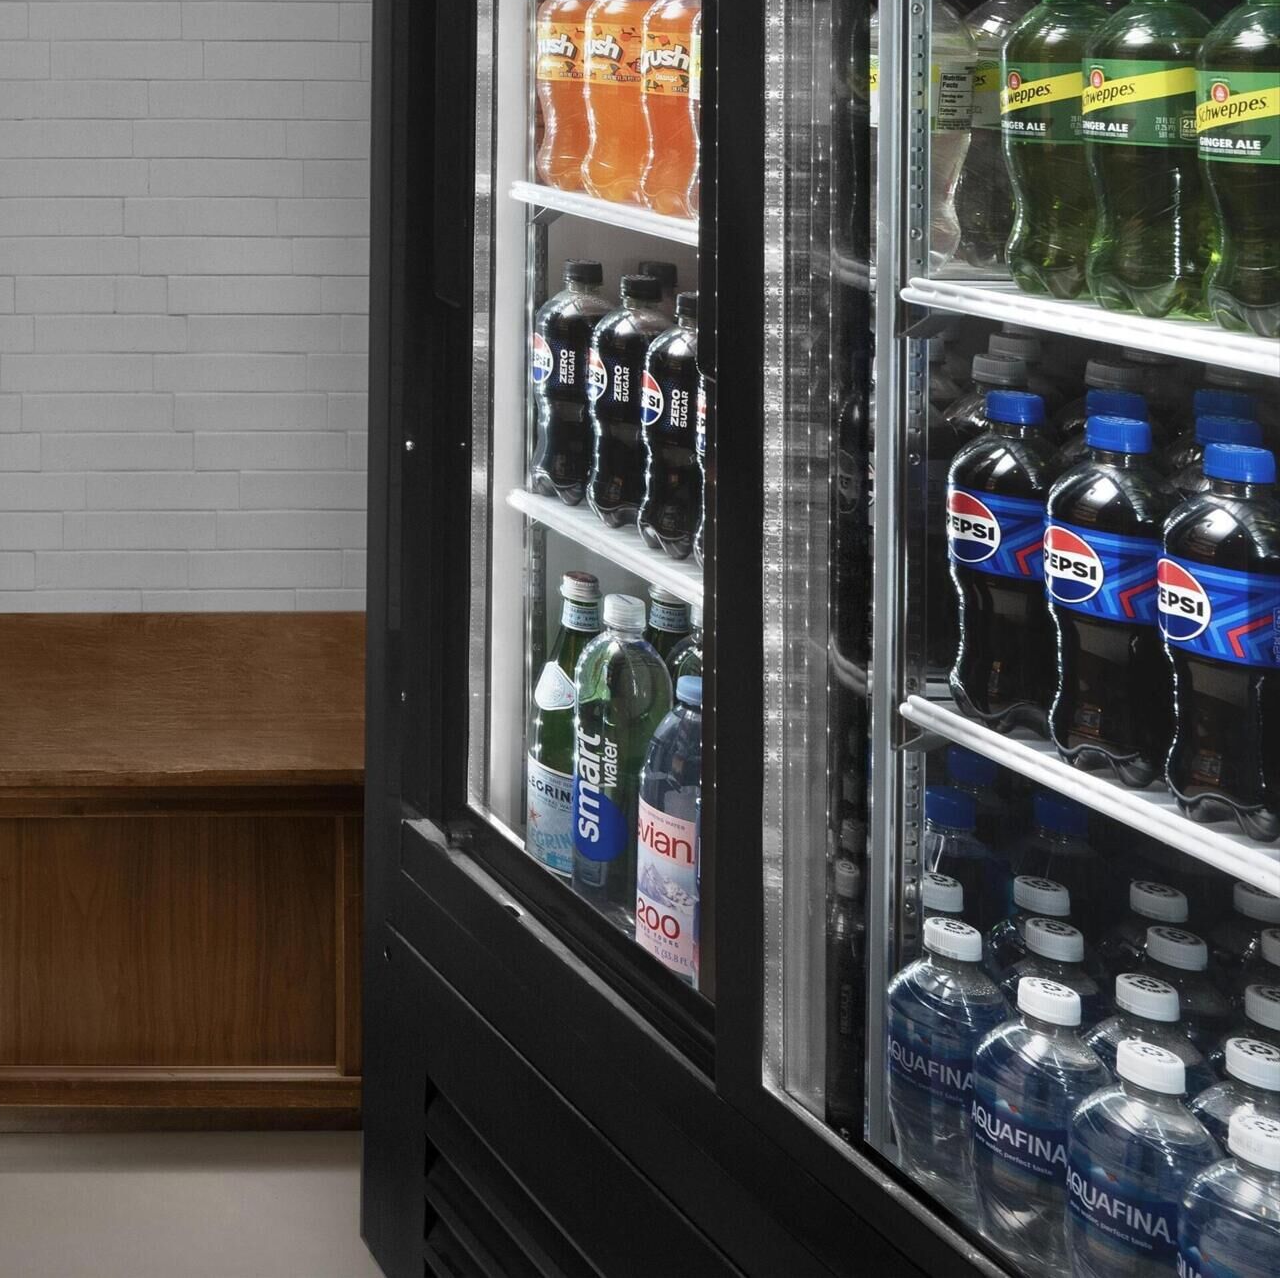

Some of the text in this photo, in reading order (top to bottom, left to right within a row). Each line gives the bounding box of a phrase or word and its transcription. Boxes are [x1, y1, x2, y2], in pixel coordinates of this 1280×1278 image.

[1026, 122, 1046, 132] ALE
[1108, 122, 1129, 133] ALE
[1197, 95, 1269, 124] Schweppes
[1199, 137, 1261, 150] GINGER ALE
[559, 349, 568, 384] ZERO
[568, 350, 576, 384] SUGAR
[613, 365, 623, 402] ZERO
[670, 389, 681, 428] ZERO
[681, 391, 689, 428] SUGAR
[603, 739, 619, 788] water
[575, 727, 601, 844] smart
[888, 1037, 975, 1092] AQUAFINA
[971, 1100, 1069, 1168] AQUAFINA
[1004, 1152, 1032, 1169] perfect
[1066, 1164, 1171, 1244] AQUAFINA
[1100, 1221, 1130, 1241] perfect
